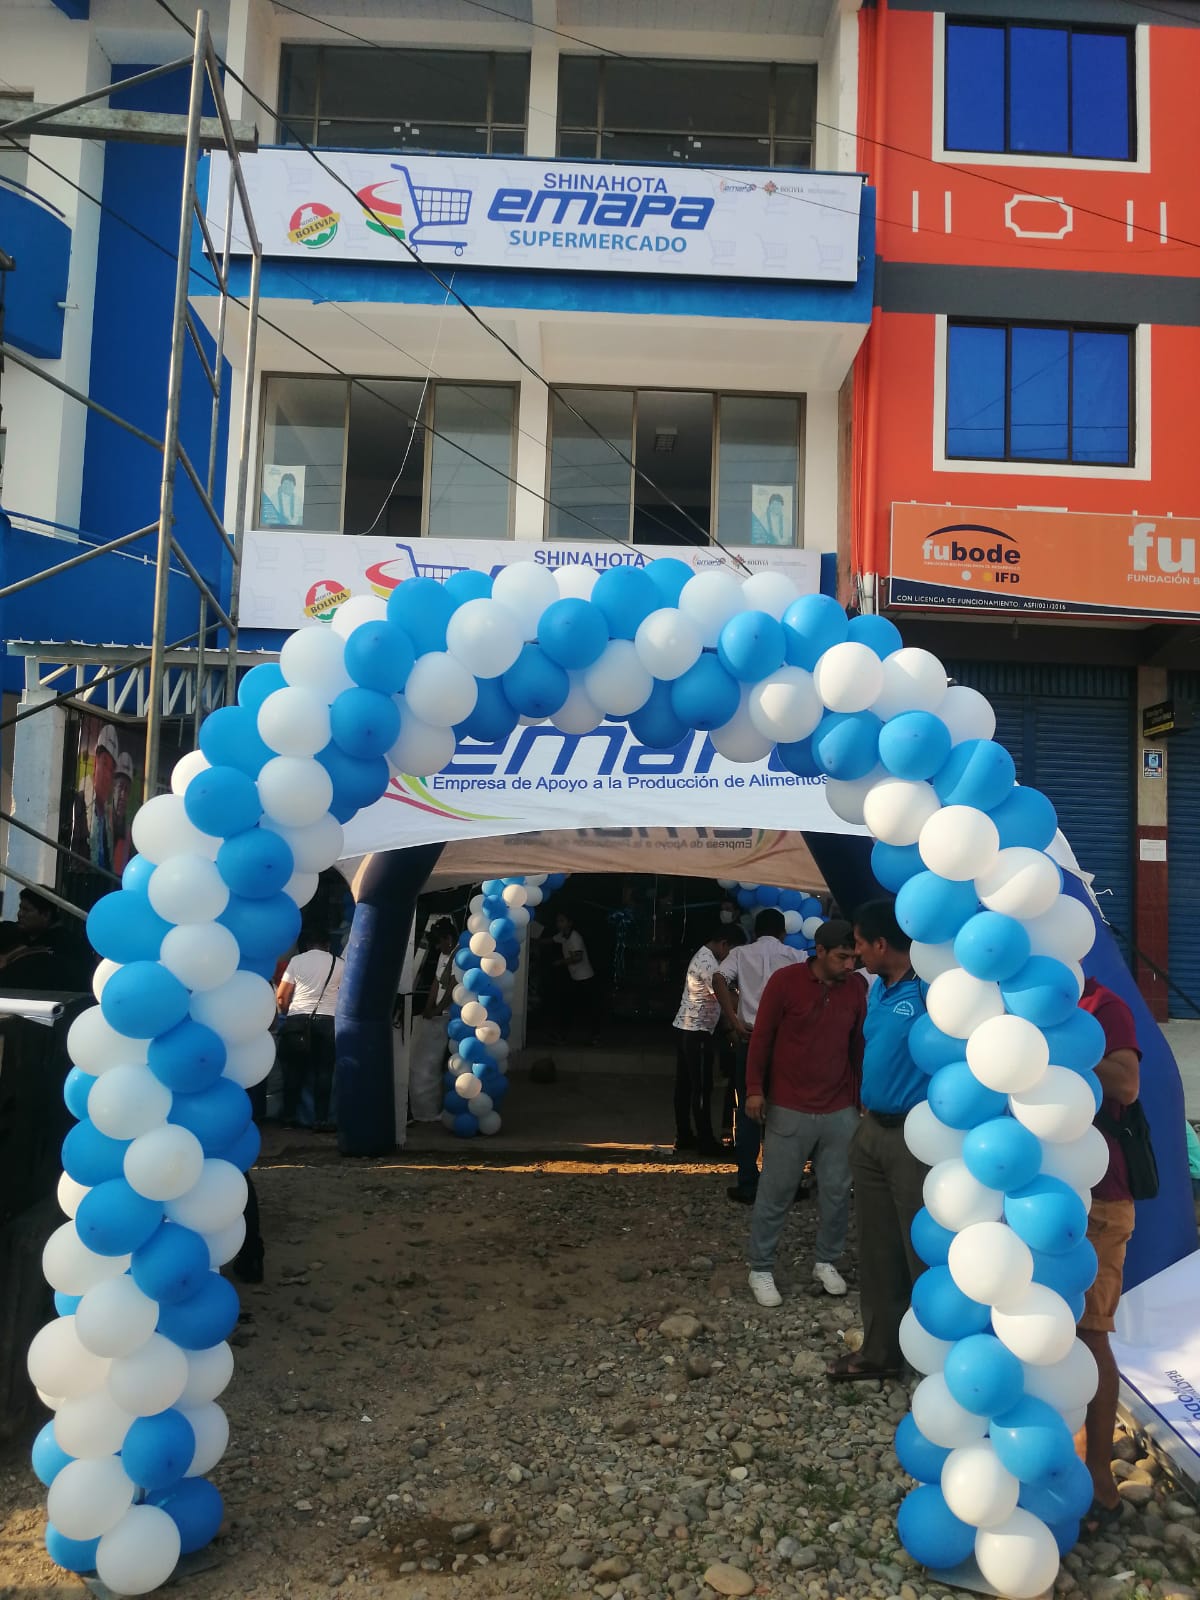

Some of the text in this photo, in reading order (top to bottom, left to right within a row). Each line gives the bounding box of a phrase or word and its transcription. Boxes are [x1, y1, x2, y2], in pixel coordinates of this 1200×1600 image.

[543, 172, 668, 193] SHINAHOTA
[487, 188, 715, 230] emapa
[295, 216, 336, 239] BOLIVIA
[509, 230, 687, 253] SUPERMERCADO
[922, 539, 1021, 565] fubode
[1128, 522, 1196, 574] fu
[534, 550, 646, 568] SHINAHOTA
[995, 572, 1020, 583] IFD
[1127, 573, 1190, 585] FUNDACIÓN
[310, 592, 348, 614] BOLIVIA
[896, 594, 913, 602] CON
[914, 595, 945, 604] LICENCIA
[947, 597, 956, 605] DE
[433, 776, 506, 792] Empresa
[511, 776, 532, 790] de
[535, 776, 588, 793] Apoyo
[592, 780, 603, 789] a
[608, 776, 622, 789] la
[628, 775, 719, 789] Producción
[724, 774, 745, 788] de
